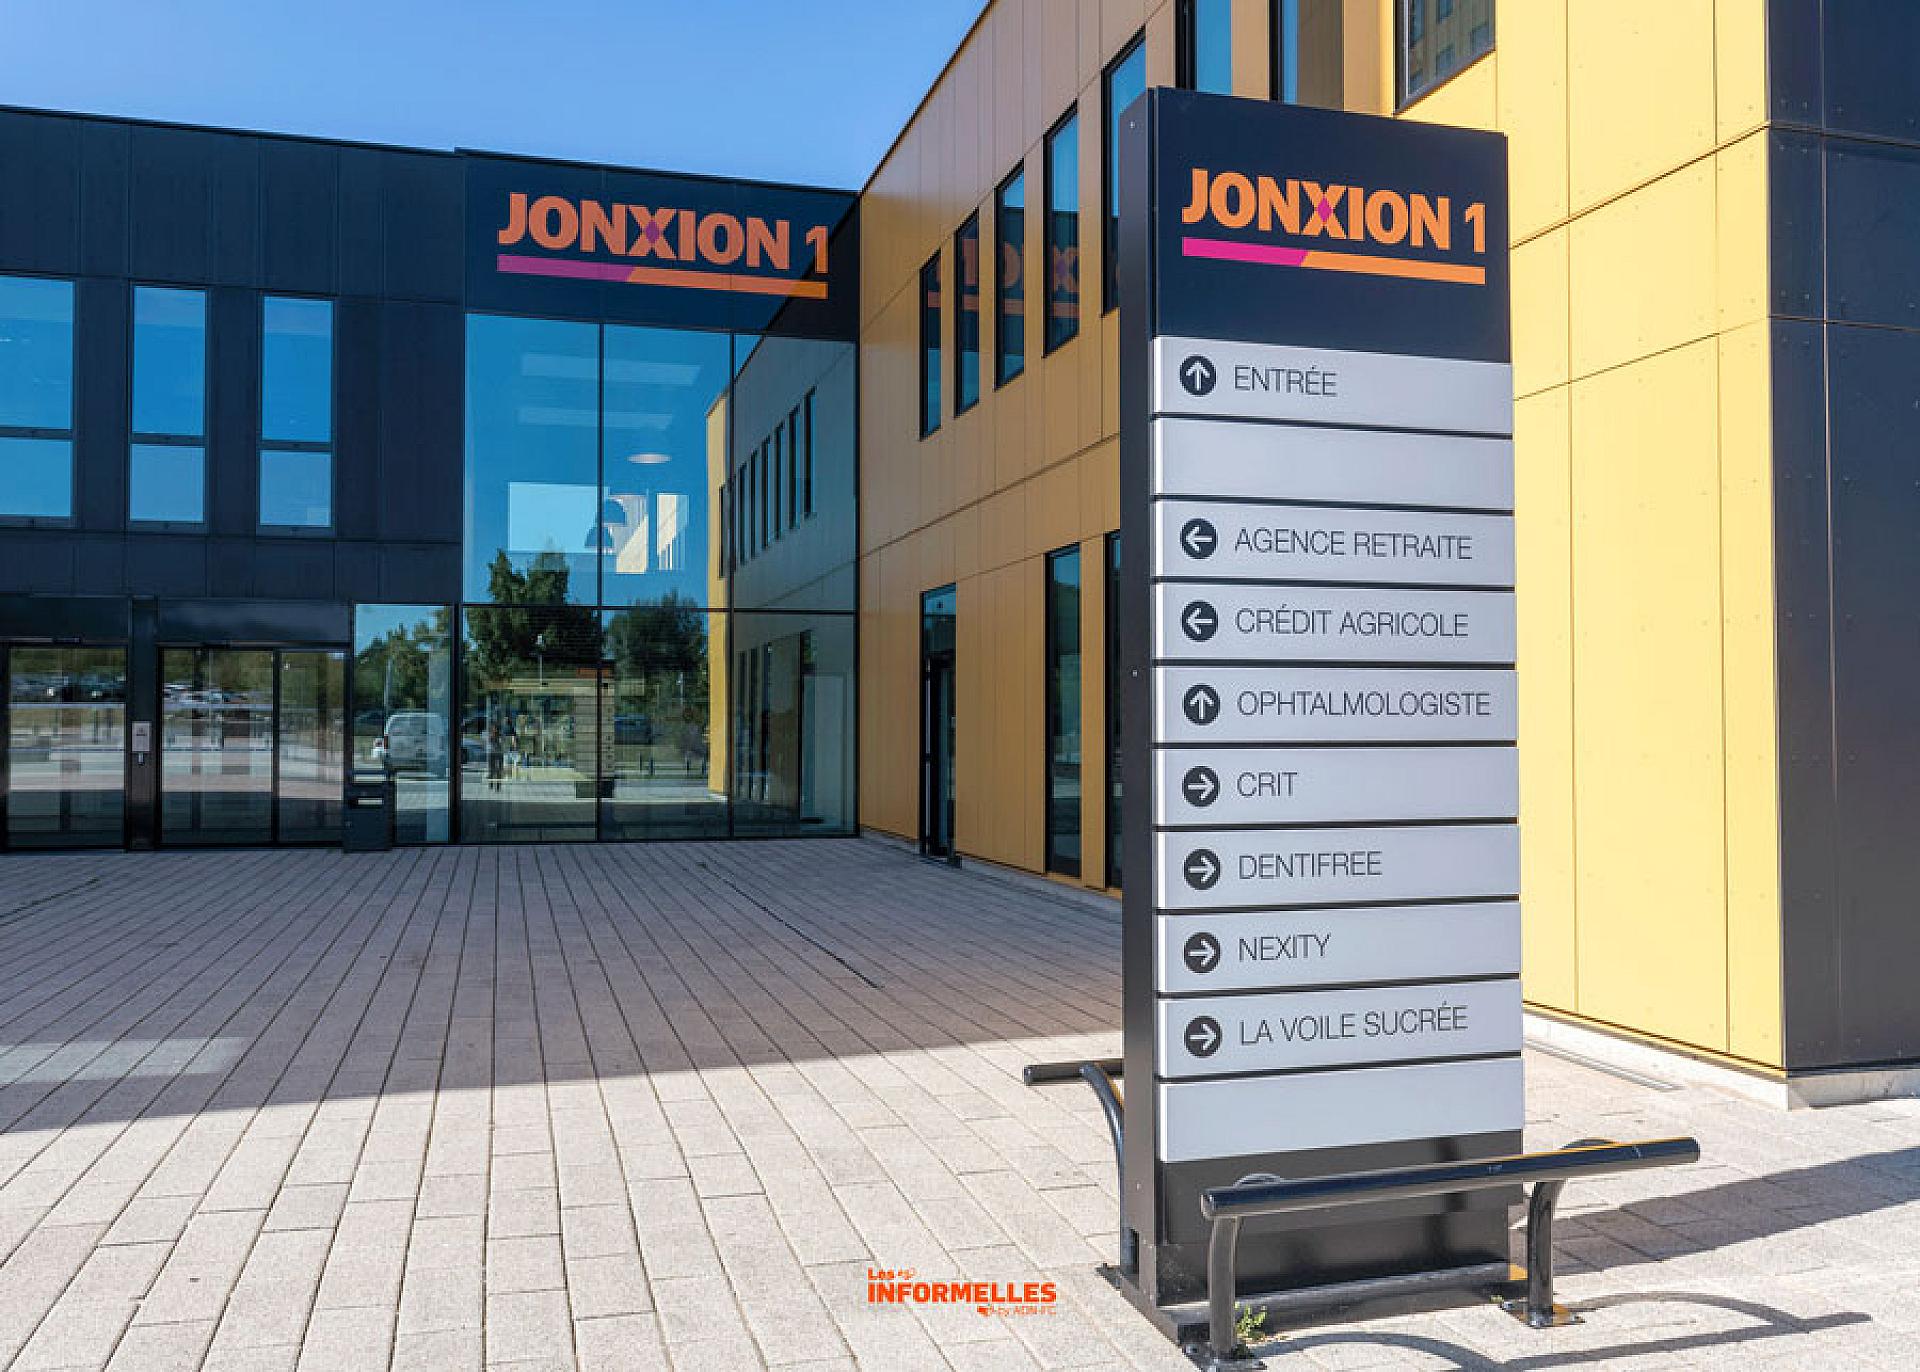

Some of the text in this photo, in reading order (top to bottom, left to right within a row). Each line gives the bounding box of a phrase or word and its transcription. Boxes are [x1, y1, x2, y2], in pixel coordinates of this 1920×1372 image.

[1181, 168, 1486, 254] JONXION 1
[498, 192, 829, 274] JONXION 1
[1233, 365, 1338, 397] ENTRÉE
[1234, 527, 1473, 560] AGENCE RETRAITE
[1235, 604, 1469, 638] CRÉDIT AGRICOLE
[1236, 690, 1492, 718] OPHTALMOLOGISTE
[1236, 771, 1298, 799] CRIT
[1238, 850, 1383, 880] DENTIFREE
[1238, 933, 1332, 963] NEXITY
[1239, 1002, 1469, 1047] LA VOILE SUCRÉE
